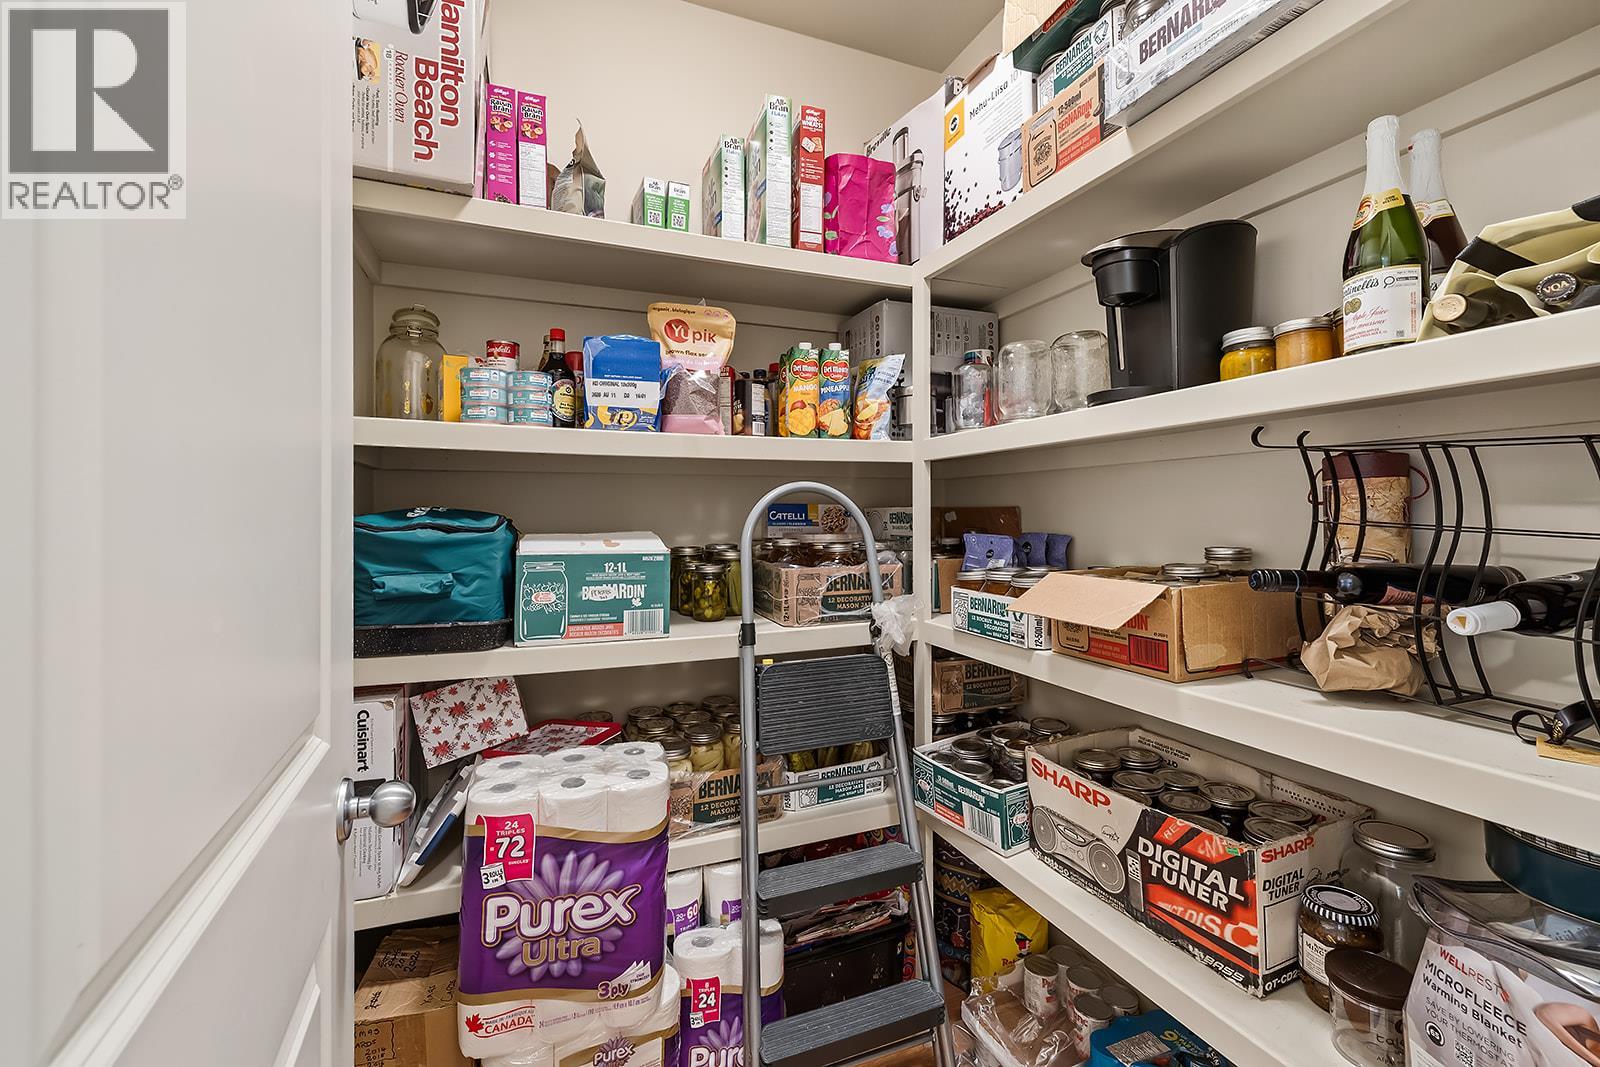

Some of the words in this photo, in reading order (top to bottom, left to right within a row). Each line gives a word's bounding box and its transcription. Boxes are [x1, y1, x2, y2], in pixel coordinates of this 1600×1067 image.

[394, 50, 409, 92] Roaster
[440, 0, 465, 128] amilton
[394, 92, 409, 123] Oven
[414, 57, 440, 162] Beach
[490, 98, 513, 109] Raisin
[492, 104, 510, 113] Bran
[521, 105, 544, 116] Raisin
[769, 102, 789, 112] Bran
[524, 112, 541, 120] Bran
[724, 140, 742, 151] Bran
[794, 384, 818, 393] MANGO
[769, 510, 805, 520] CATELLI
[836, 596, 872, 604] DECORATIV
[356, 710, 370, 772] Cuisinart
[1031, 758, 1110, 807] SHARP
[710, 808, 736, 817] MASON
[496, 828, 526, 836] TRIPLES
[504, 820, 518, 830] 24
[496, 835, 525, 858] 72
[1262, 836, 1314, 864] SHARP
[482, 872, 490, 884] 3
[1138, 836, 1244, 902] DIGITAL
[1262, 868, 1304, 892] DIGITAL
[1148, 859, 1229, 912] TUNER
[1268, 881, 1300, 901] TUNER
[484, 886, 640, 945] Purex
[686, 904, 698, 918] 60
[1184, 909, 1259, 955] DISC
[523, 936, 601, 966] Ultra
[698, 992, 716, 1009] 24
[1425, 960, 1528, 1036] MICROFLEECE
[1423, 974, 1468, 1014] Warming
[1472, 1008, 1523, 1048] Blanket
[1425, 1005, 1448, 1028] YOUR
[484, 1016, 534, 1035] CANADA
[1426, 996, 1448, 1016] SAVE
[1462, 1022, 1516, 1062] LOWERING
[594, 1044, 635, 1067] Purex
